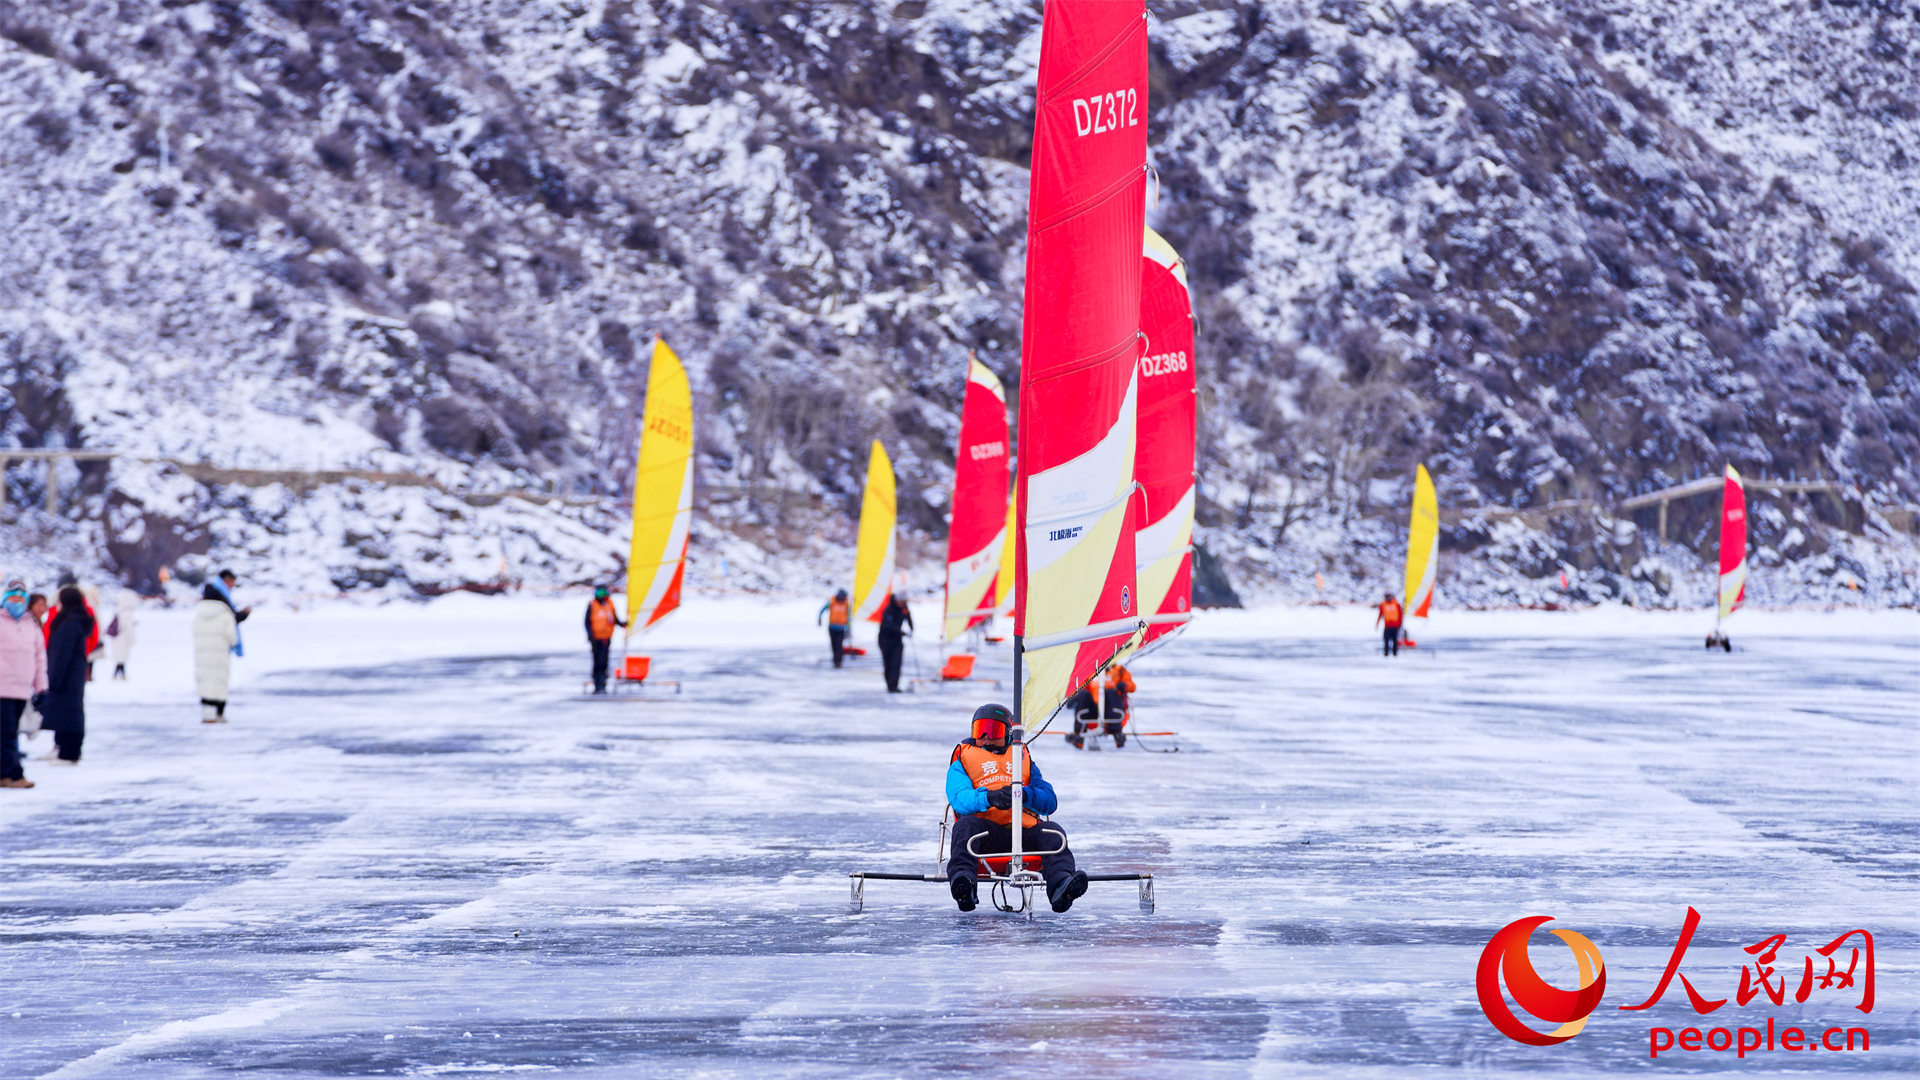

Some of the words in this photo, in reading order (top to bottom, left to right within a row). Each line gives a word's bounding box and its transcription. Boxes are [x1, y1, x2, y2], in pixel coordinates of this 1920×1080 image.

[1072, 87, 1138, 137] DZ372
[1140, 350, 1188, 377] DZ368
[1013, 790, 1022, 798] 12
